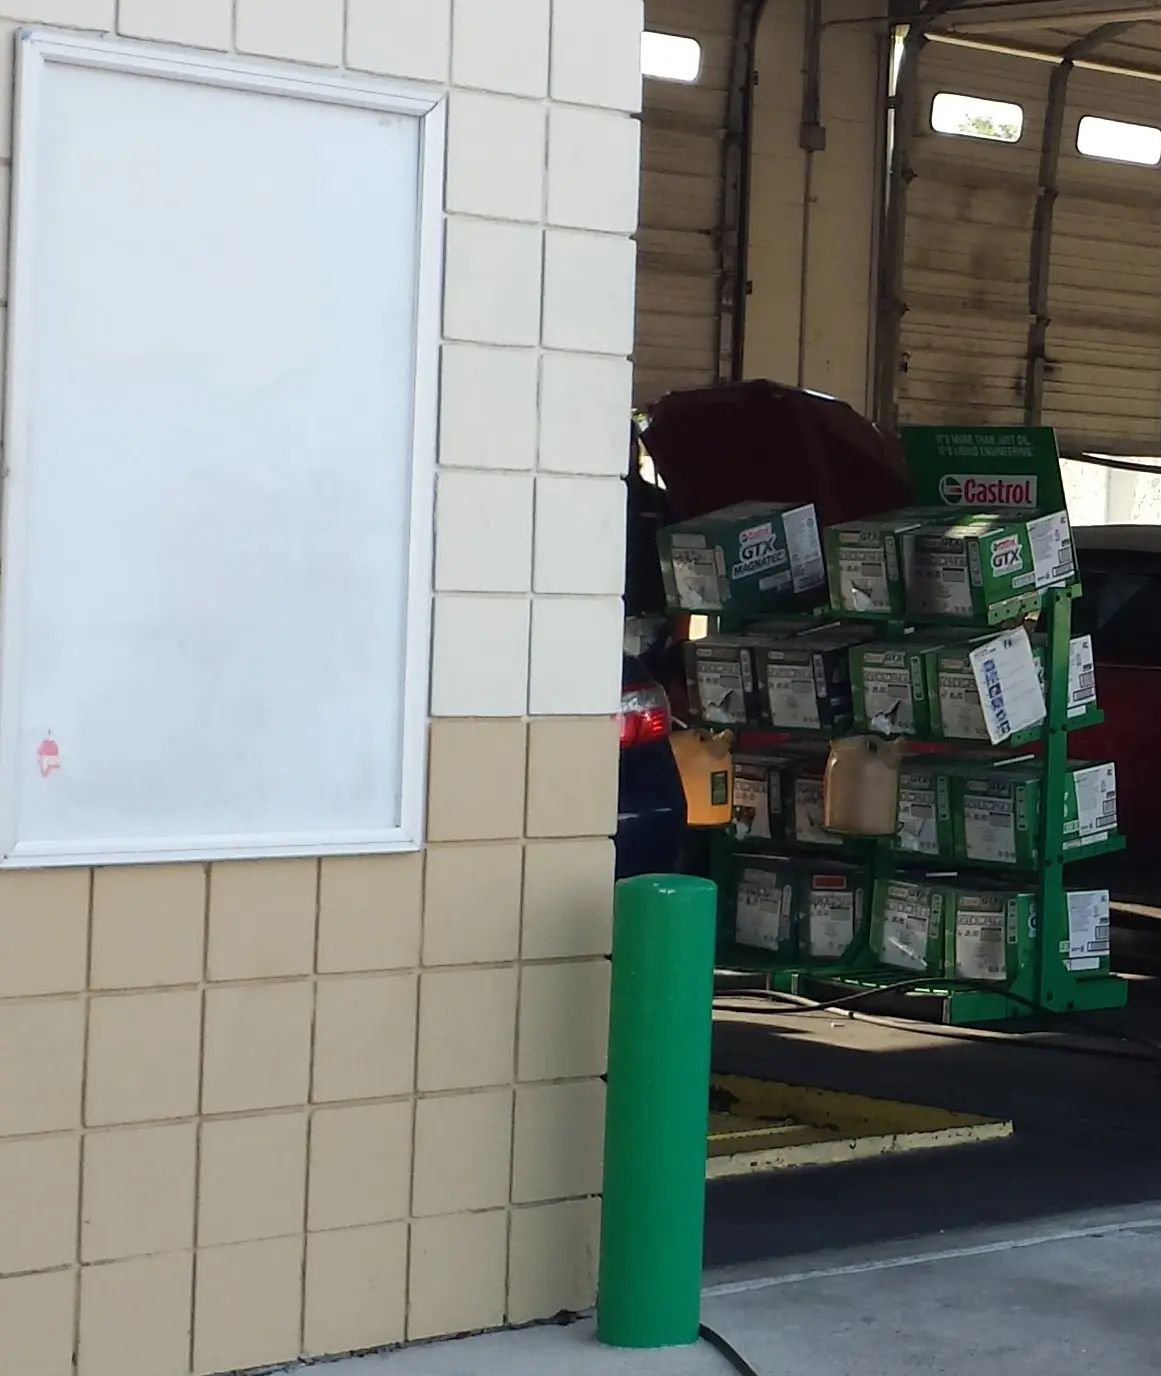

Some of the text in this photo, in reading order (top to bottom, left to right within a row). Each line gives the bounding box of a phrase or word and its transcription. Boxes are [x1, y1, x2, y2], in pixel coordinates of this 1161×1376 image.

[963, 478, 1032, 504] Castrol
[742, 541, 776, 560] GTX
[993, 548, 1020, 567] GTX
